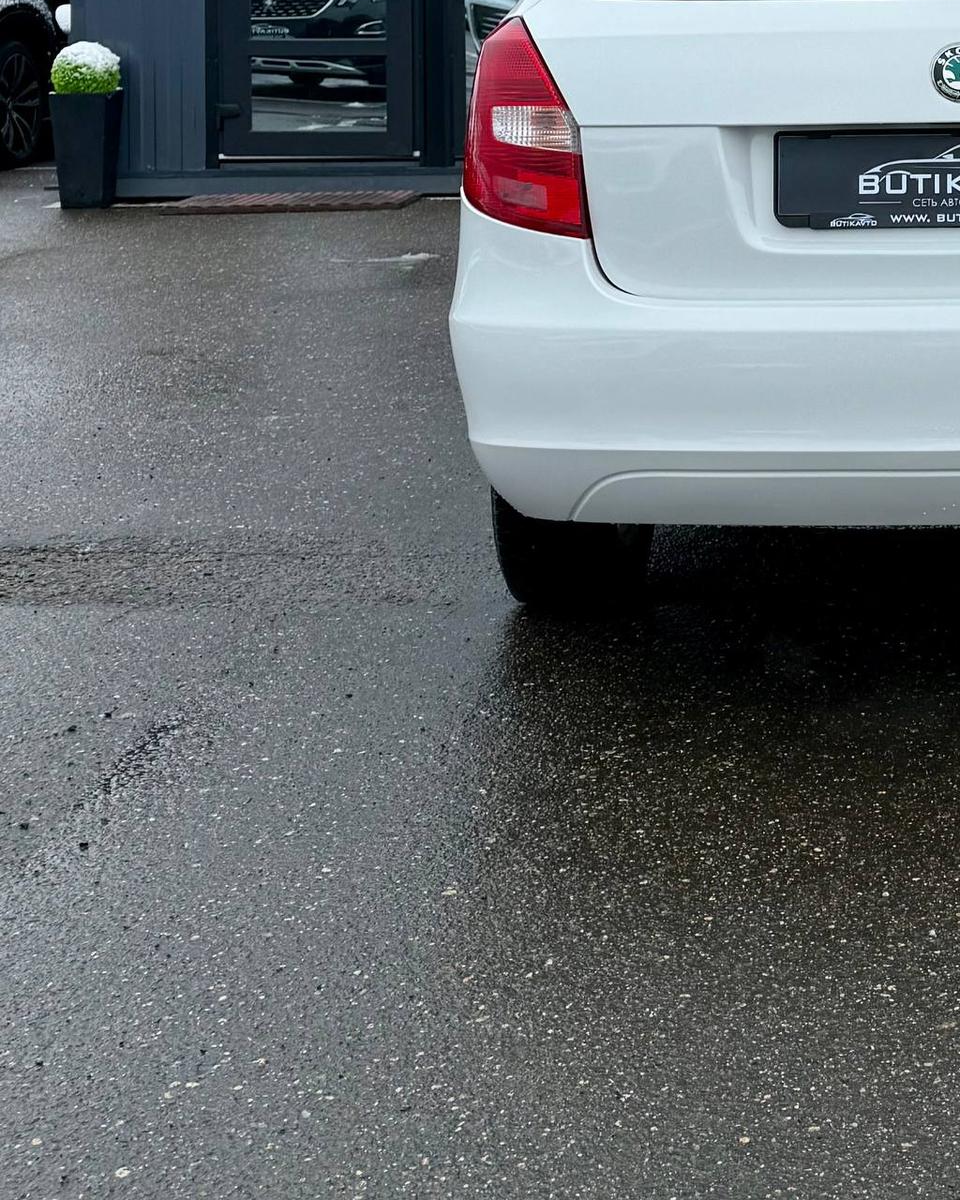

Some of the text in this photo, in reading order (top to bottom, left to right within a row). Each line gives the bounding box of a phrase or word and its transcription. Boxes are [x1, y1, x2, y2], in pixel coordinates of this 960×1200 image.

[912, 197, 938, 208] СЕТЬ
[830, 219, 878, 228] BUTIKAVTO
[890, 214, 931, 224] WWW.
